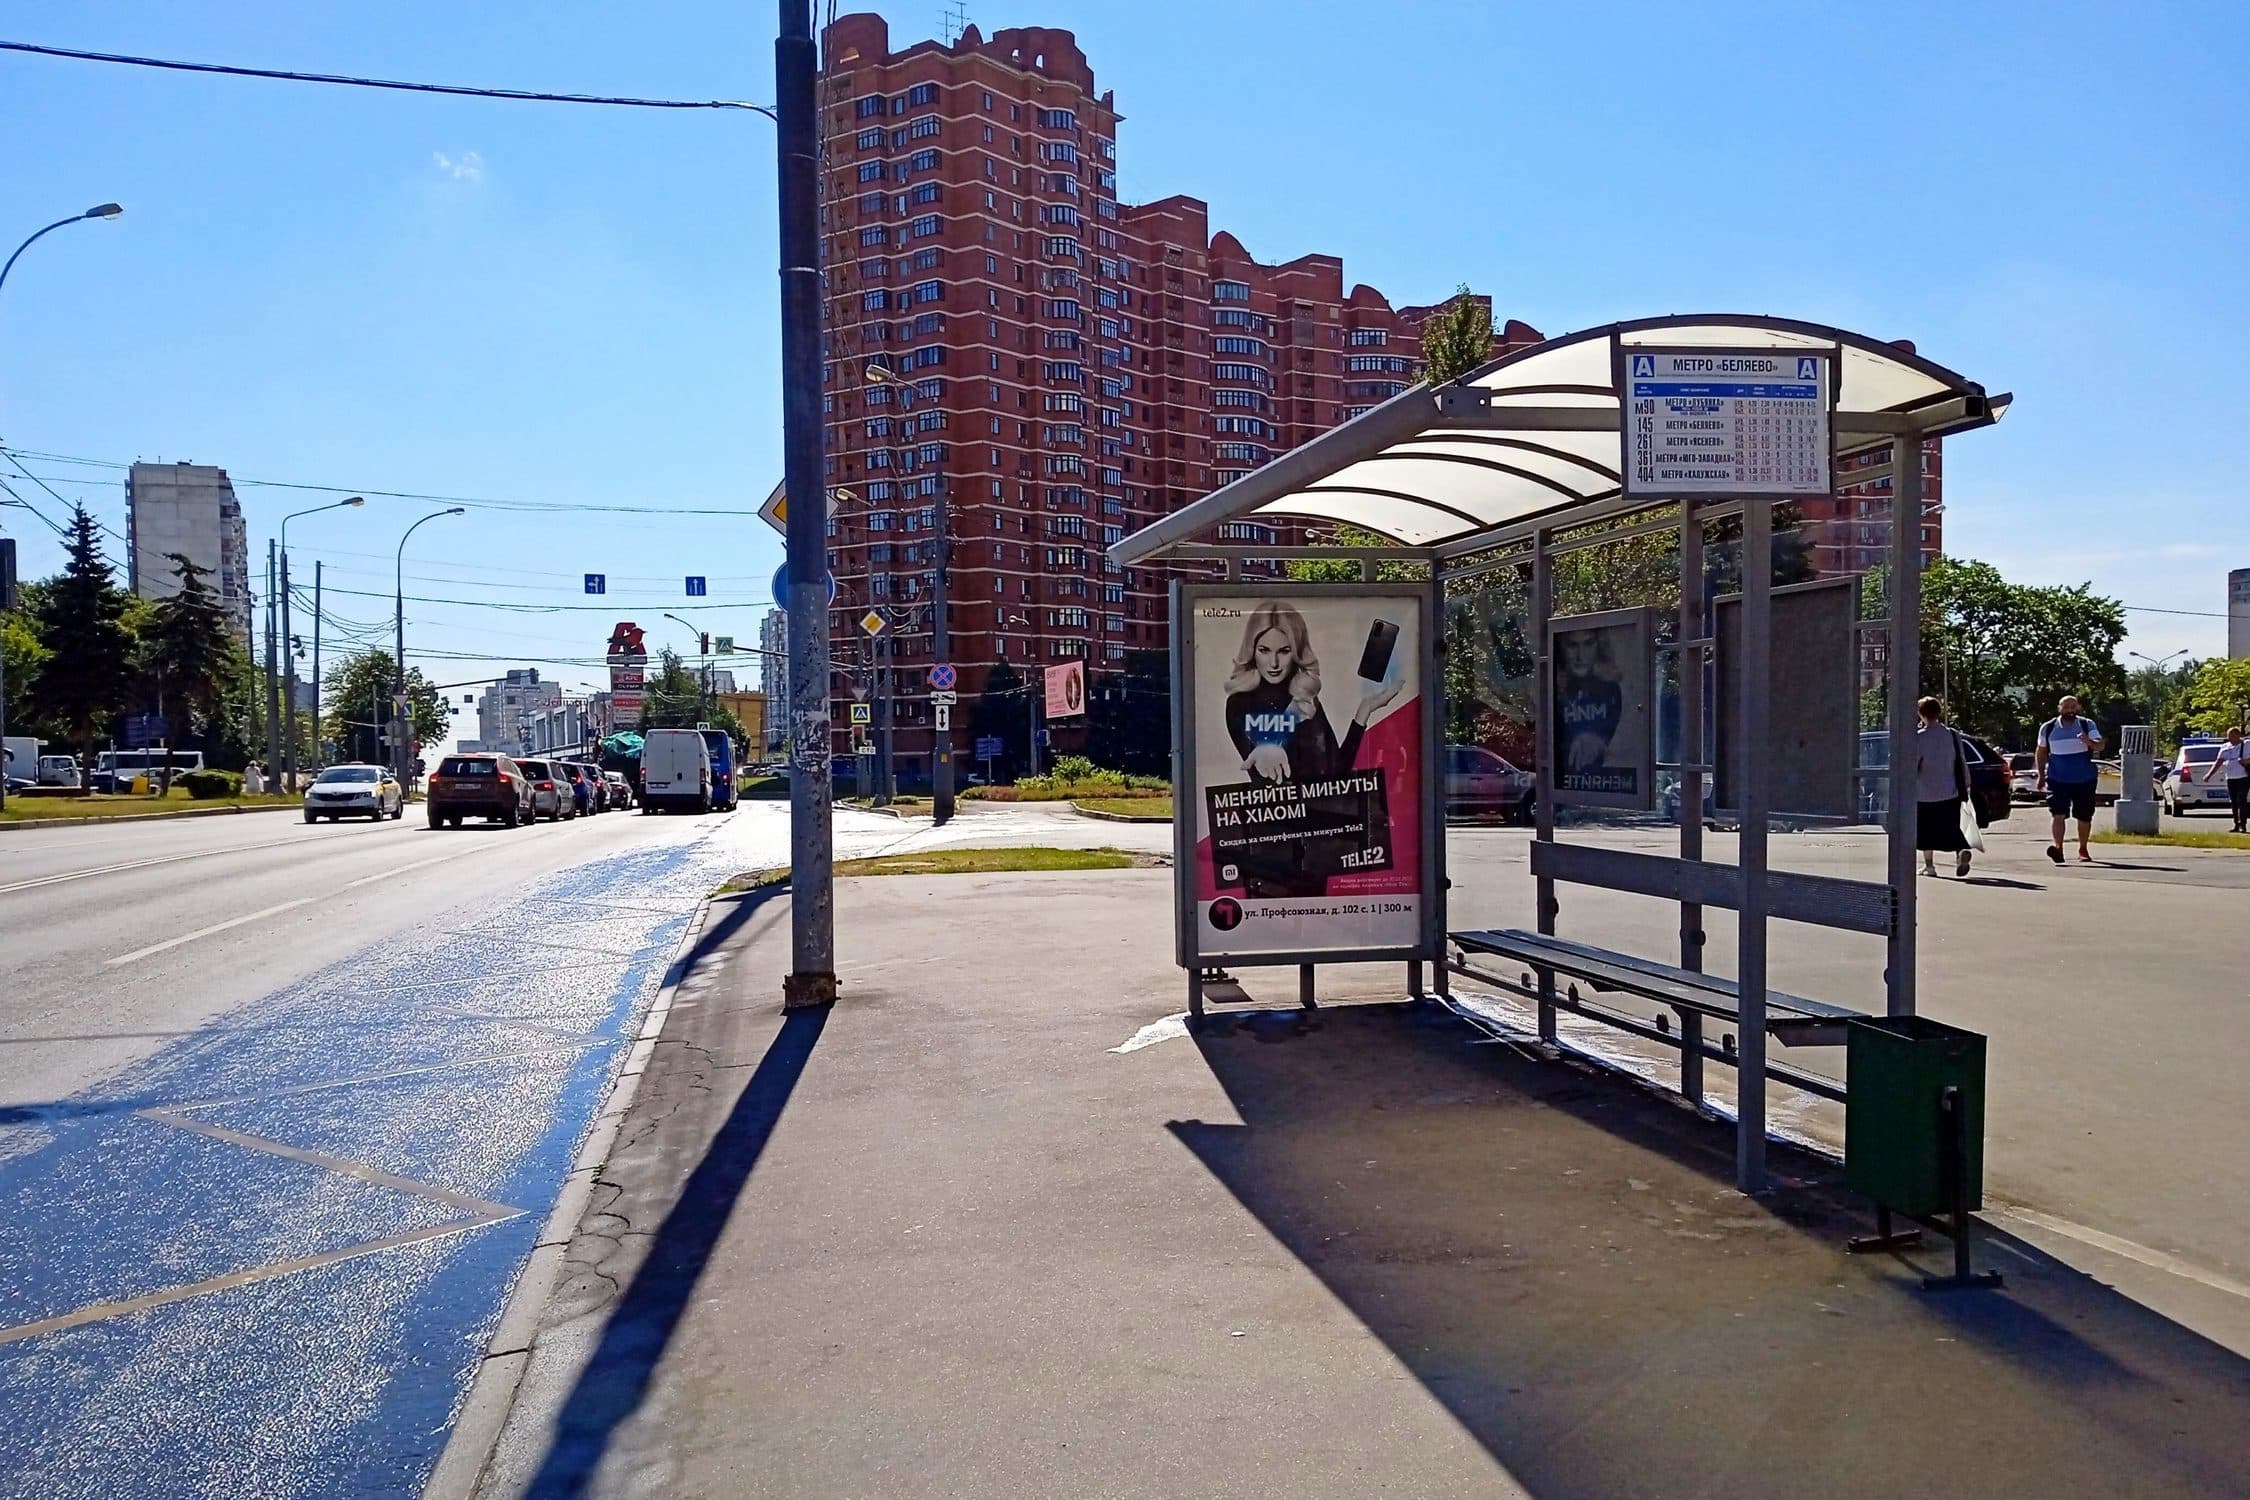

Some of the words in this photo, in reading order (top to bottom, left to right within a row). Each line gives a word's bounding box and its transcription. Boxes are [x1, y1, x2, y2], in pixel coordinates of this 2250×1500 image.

[1635, 356, 1654, 377] А
[1673, 359, 1713, 371] МЕТРО
[1637, 416, 1653, 433] 145
[1666, 421, 1688, 430] МЕТРО
[1637, 434, 1653, 449] 261
[1666, 437, 1688, 446] МЕТРО
[1637, 450, 1653, 466] 361
[1655, 454, 1678, 463] МЕТРО
[1637, 466, 1654, 482] 404
[1661, 470, 1683, 479] МЕТРО
[1202, 607, 1241, 618] tele2.ru
[1244, 713, 1295, 733] МИН
[1214, 784, 1298, 809] МЕНЯЙТЕ
[1301, 776, 1379, 799] МИНУТЫ
[1216, 811, 1242, 828] НА
[1245, 803, 1307, 824] XIAOMI
[1219, 838, 1247, 847] Скидка
[1259, 832, 1303, 843] смартфоны
[1313, 827, 1344, 837] минуты
[1344, 823, 1364, 833] Tele2
[1340, 846, 1385, 868] TELE2
[1244, 910, 1259, 920] ул.
[1261, 907, 1329, 919] Профсоюзная,
[1331, 908, 1340, 916] д.
[1342, 904, 1359, 914] 102
[1370, 904, 1376, 913] 1
[1384, 903, 1402, 913] 300
[1403, 904, 1413, 912] м
